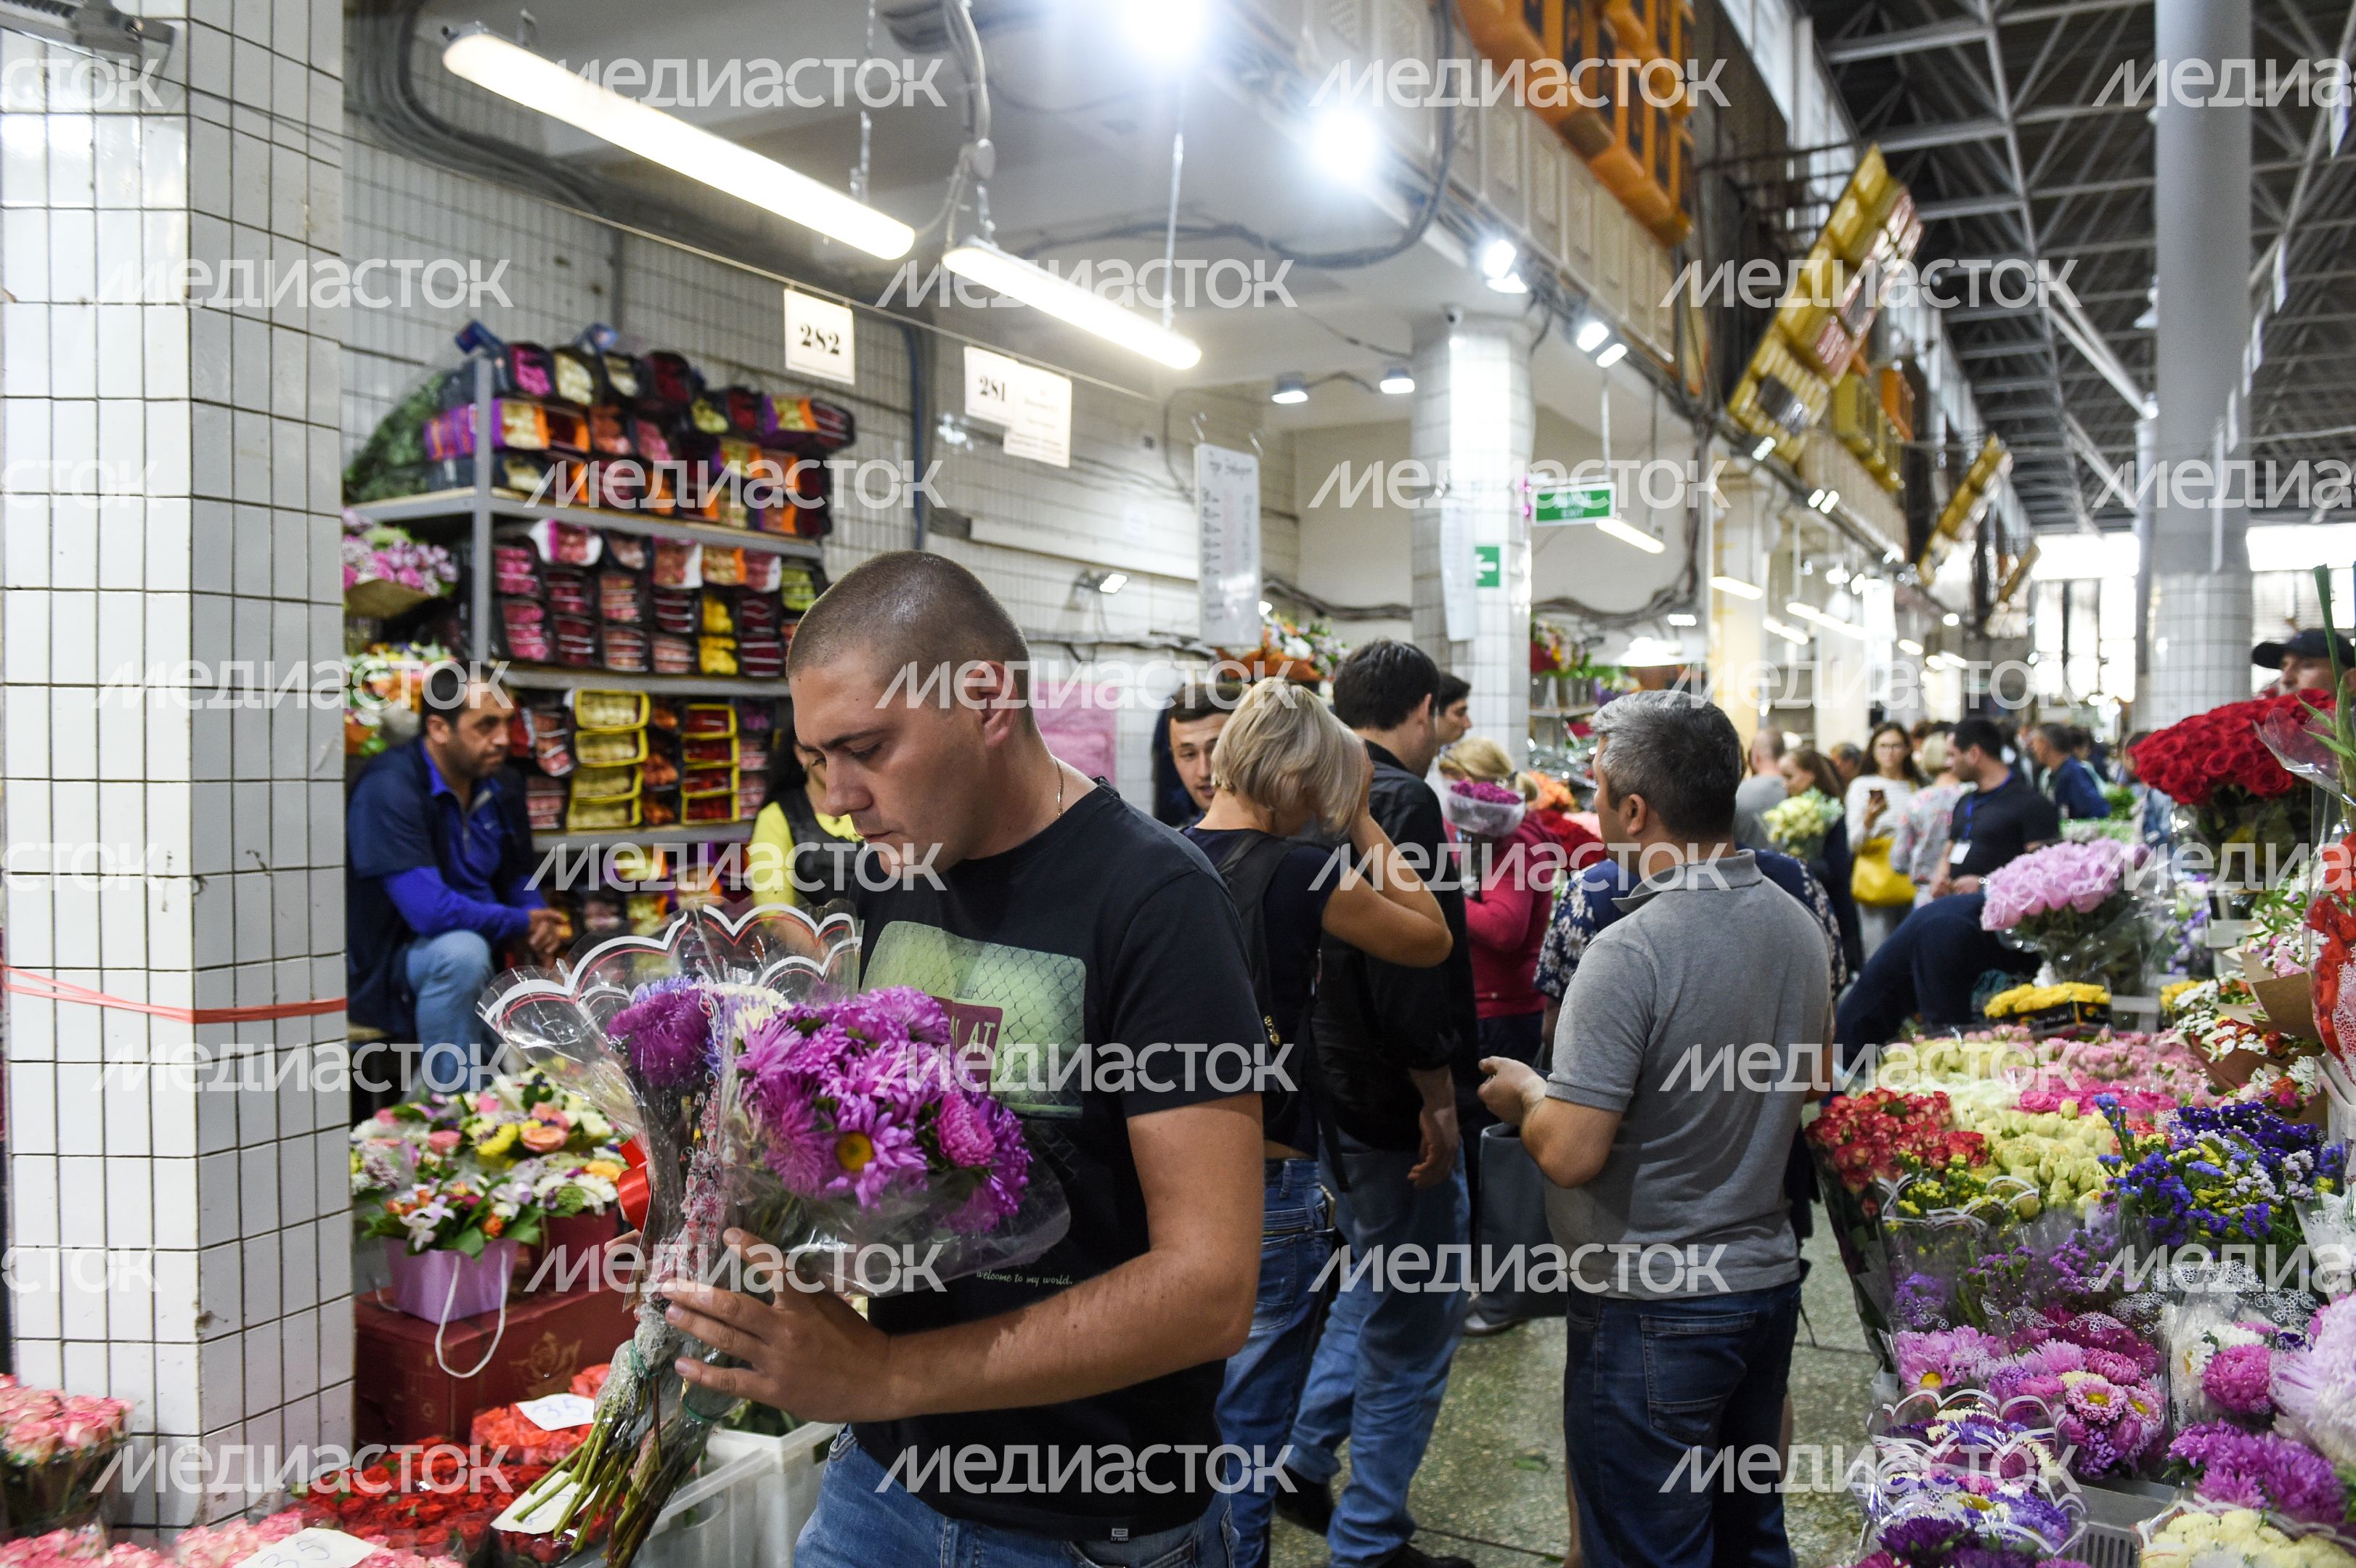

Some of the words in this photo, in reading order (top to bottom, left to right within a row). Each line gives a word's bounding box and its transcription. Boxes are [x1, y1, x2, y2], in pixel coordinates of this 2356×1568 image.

[799, 324, 840, 355] 282
[979, 376, 1006, 401] 281
[966, 1021, 996, 1055] AT
[977, 1270, 1012, 1283] welcome
[1014, 1273, 1023, 1283] to
[1026, 1275, 1040, 1288] my
[532, 1397, 585, 1419] 35
